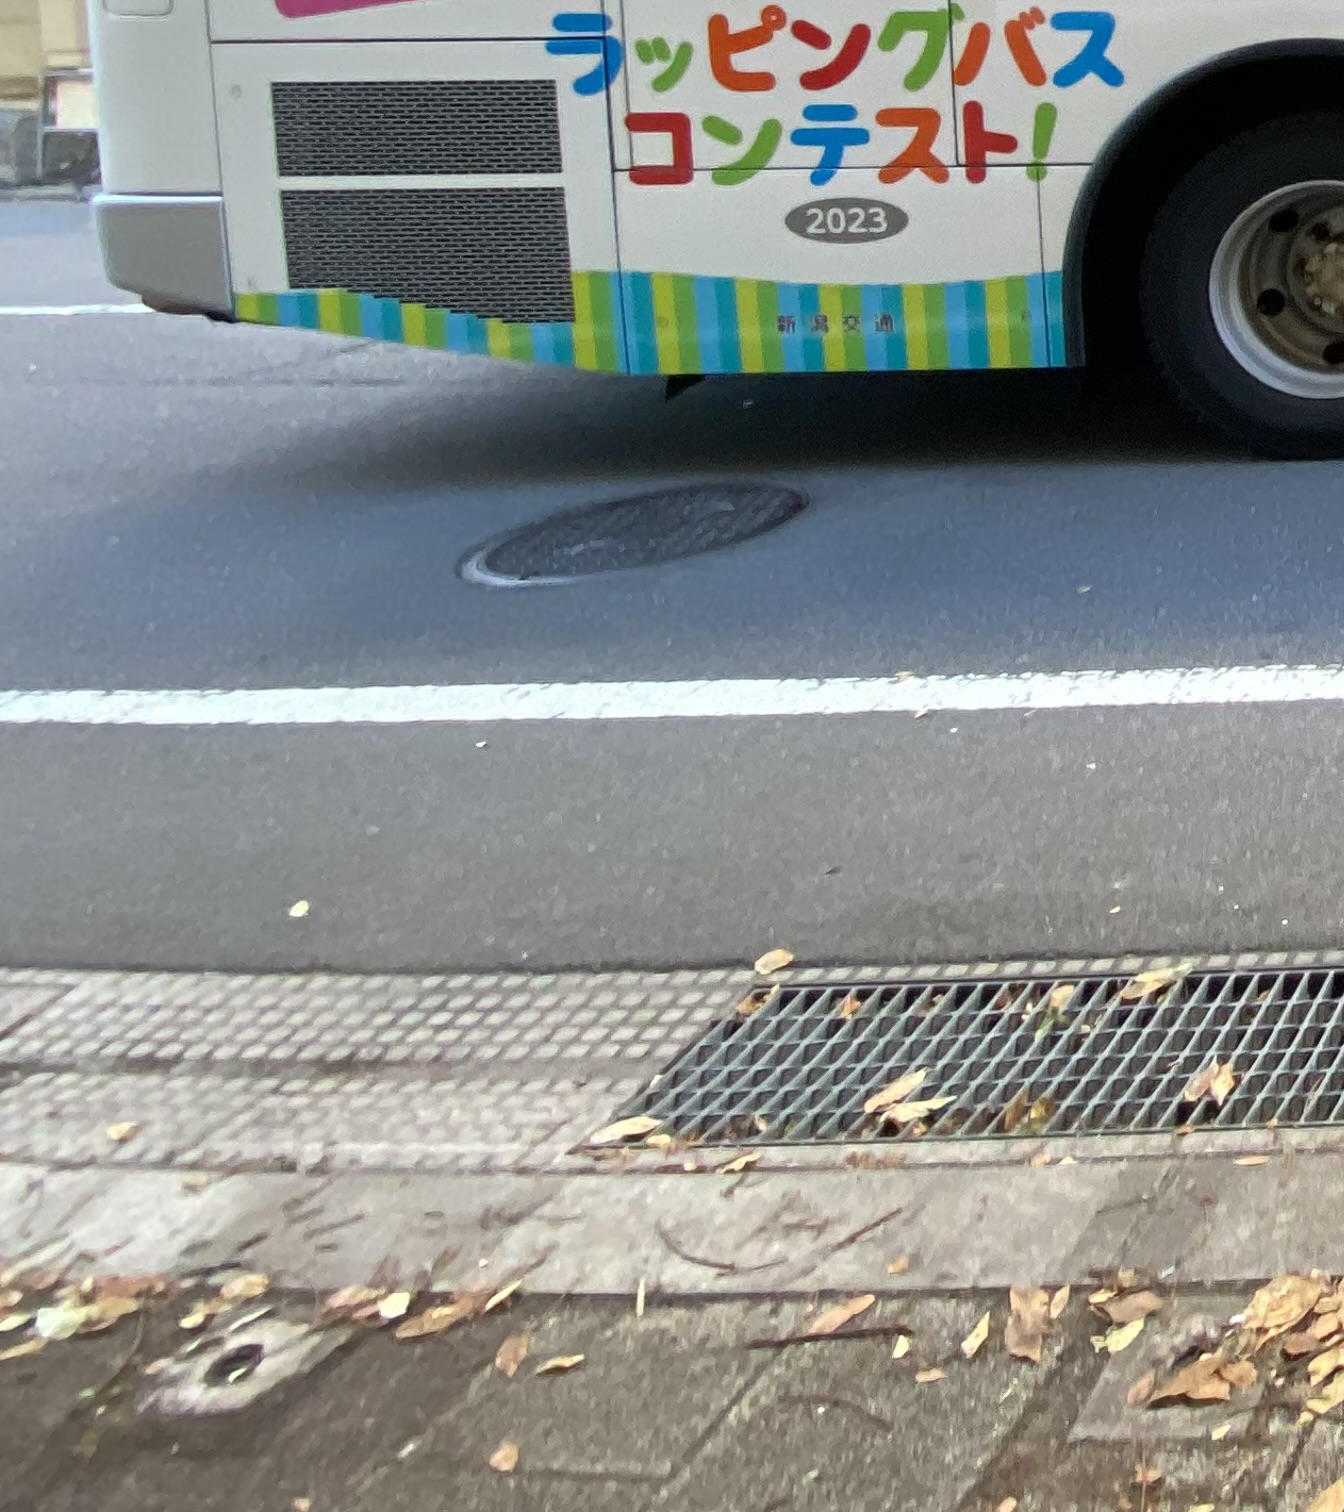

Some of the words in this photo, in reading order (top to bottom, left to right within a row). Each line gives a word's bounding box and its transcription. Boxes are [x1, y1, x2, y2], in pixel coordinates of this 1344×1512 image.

[545, 3, 1124, 95] ラッピングバス
[625, 100, 1058, 186] コンテスト!
[805, 207, 889, 235] 2023
